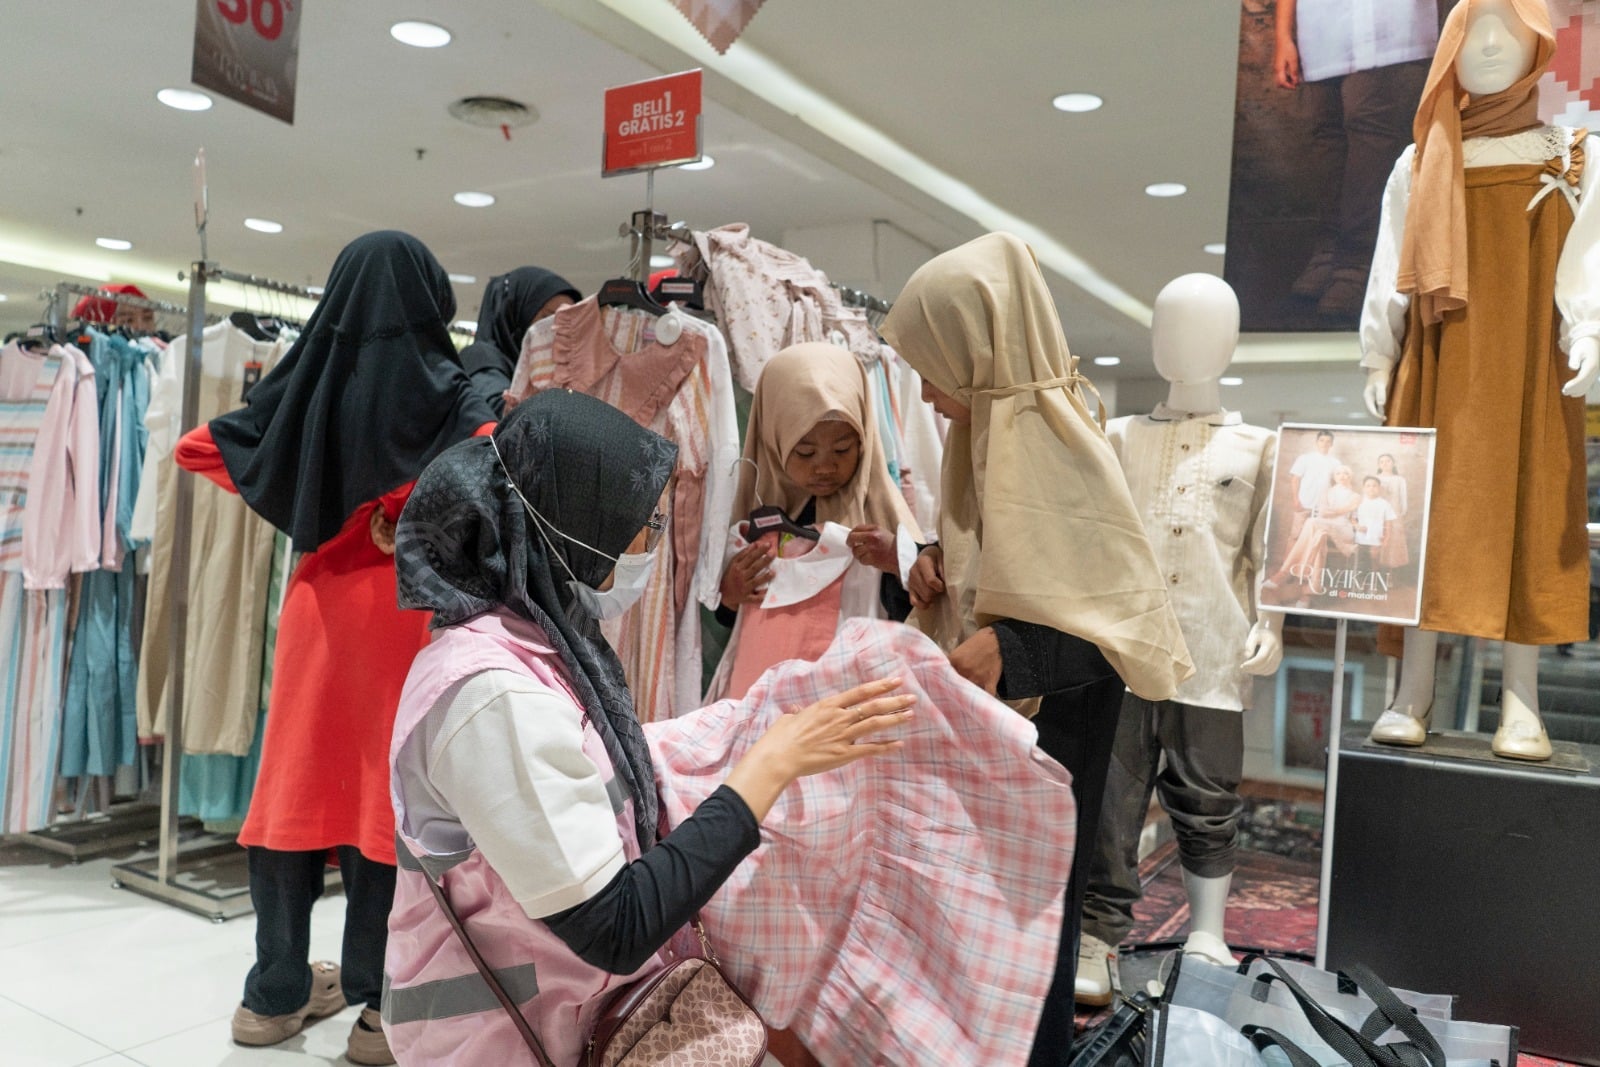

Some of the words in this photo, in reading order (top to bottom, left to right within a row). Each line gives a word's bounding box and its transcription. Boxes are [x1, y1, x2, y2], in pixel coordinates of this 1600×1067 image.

[633, 98, 662, 118] BELI
[664, 91, 672, 112] 1
[618, 113, 673, 136] GRATIS
[675, 110, 685, 126] 2
[1347, 590, 1388, 601] matahari
